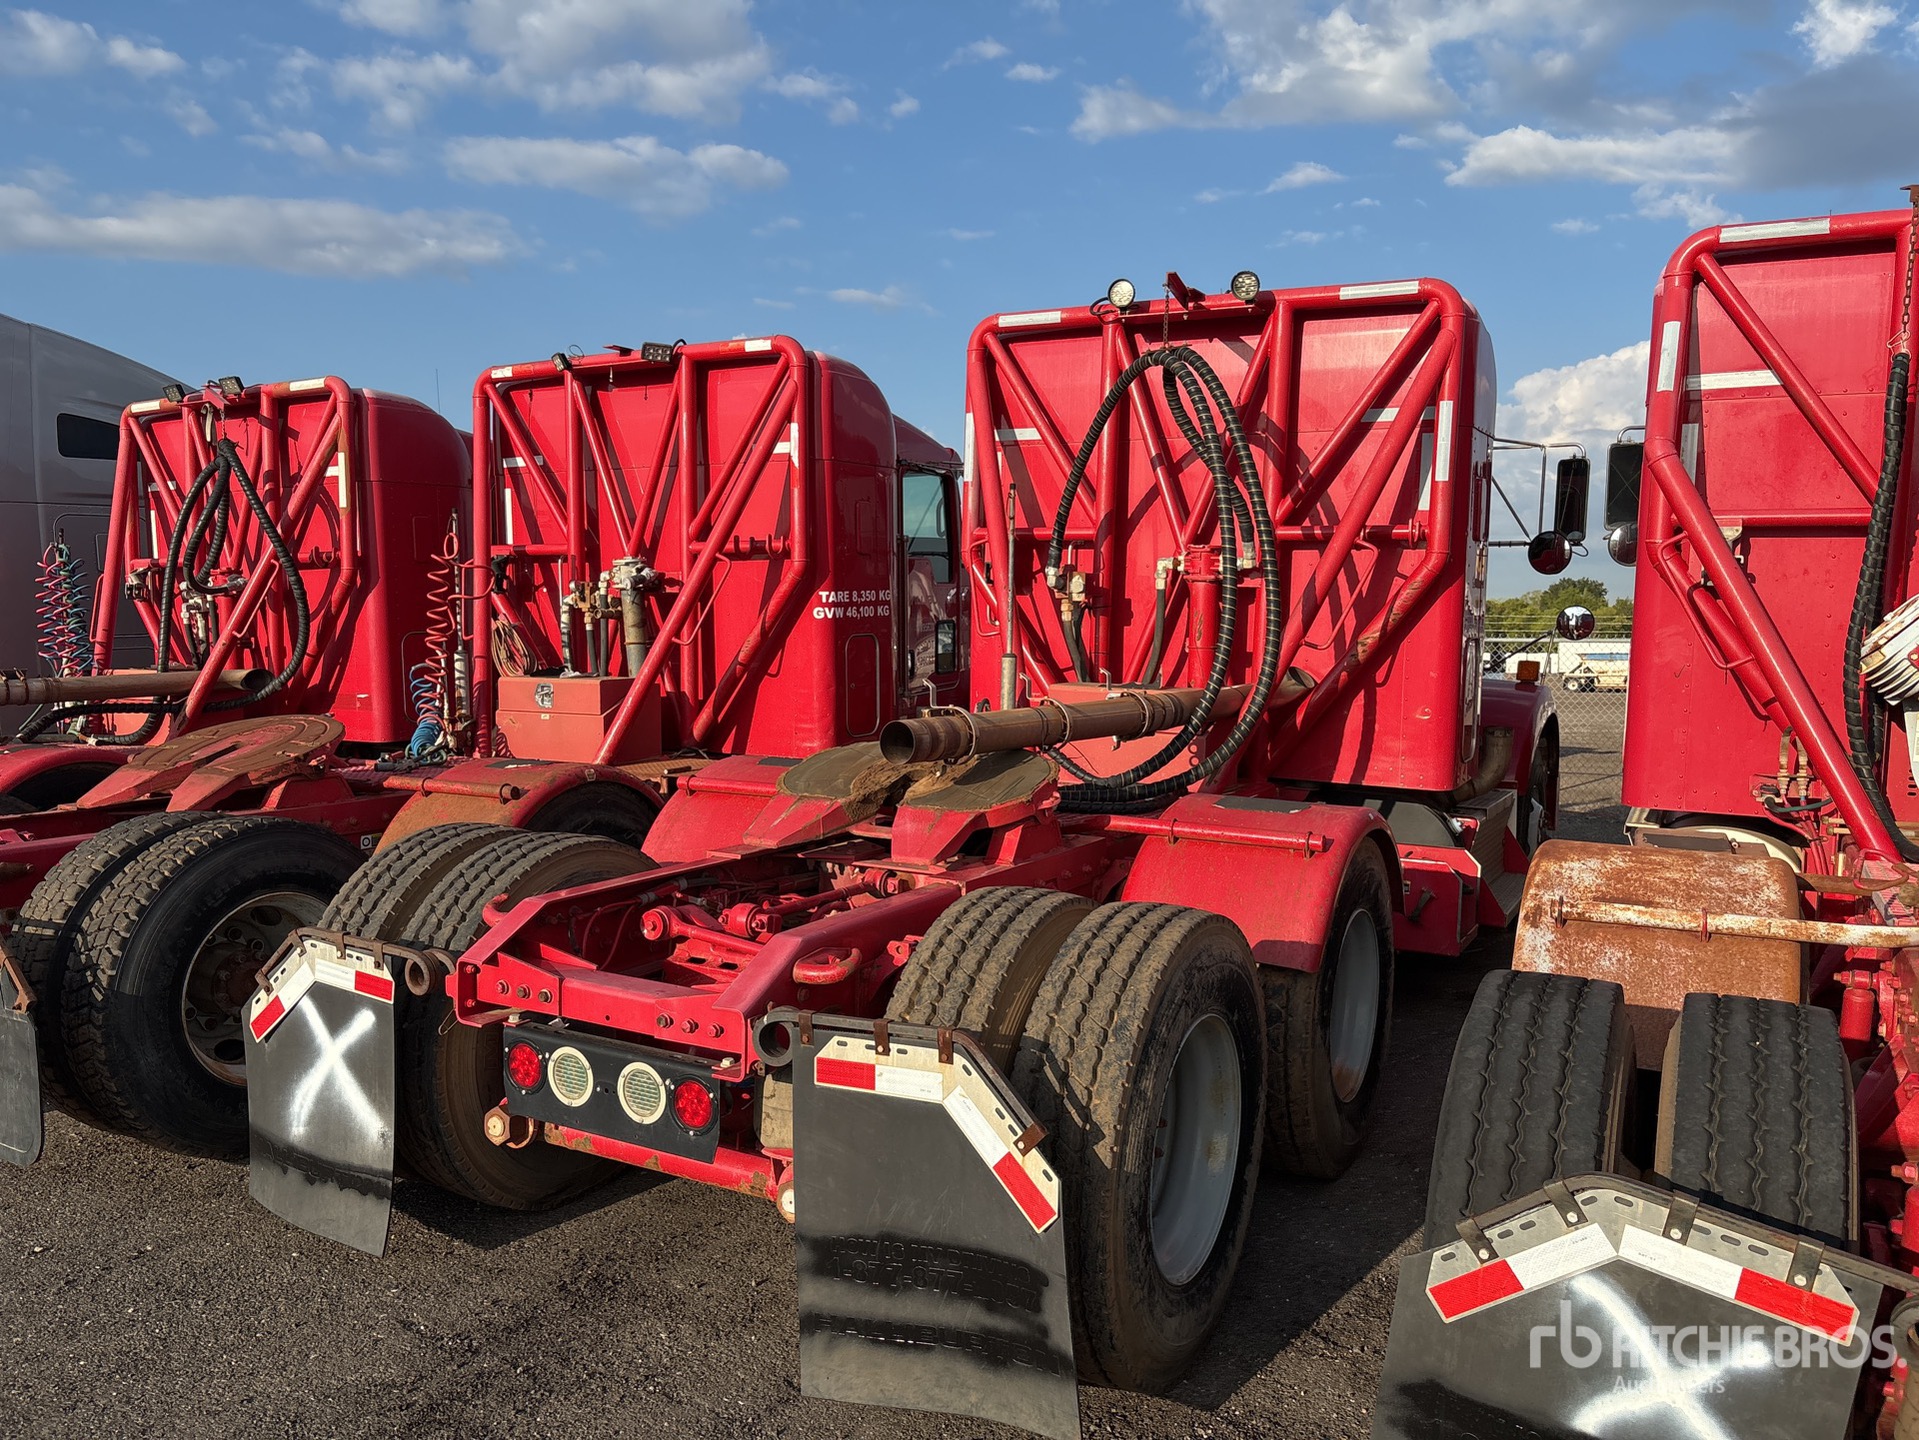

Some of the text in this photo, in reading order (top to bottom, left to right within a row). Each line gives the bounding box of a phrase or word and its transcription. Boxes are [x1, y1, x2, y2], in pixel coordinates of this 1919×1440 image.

[819, 589, 891, 605] TARE 8,350 KG
[813, 605, 890, 620] GVW 46,100 KG
